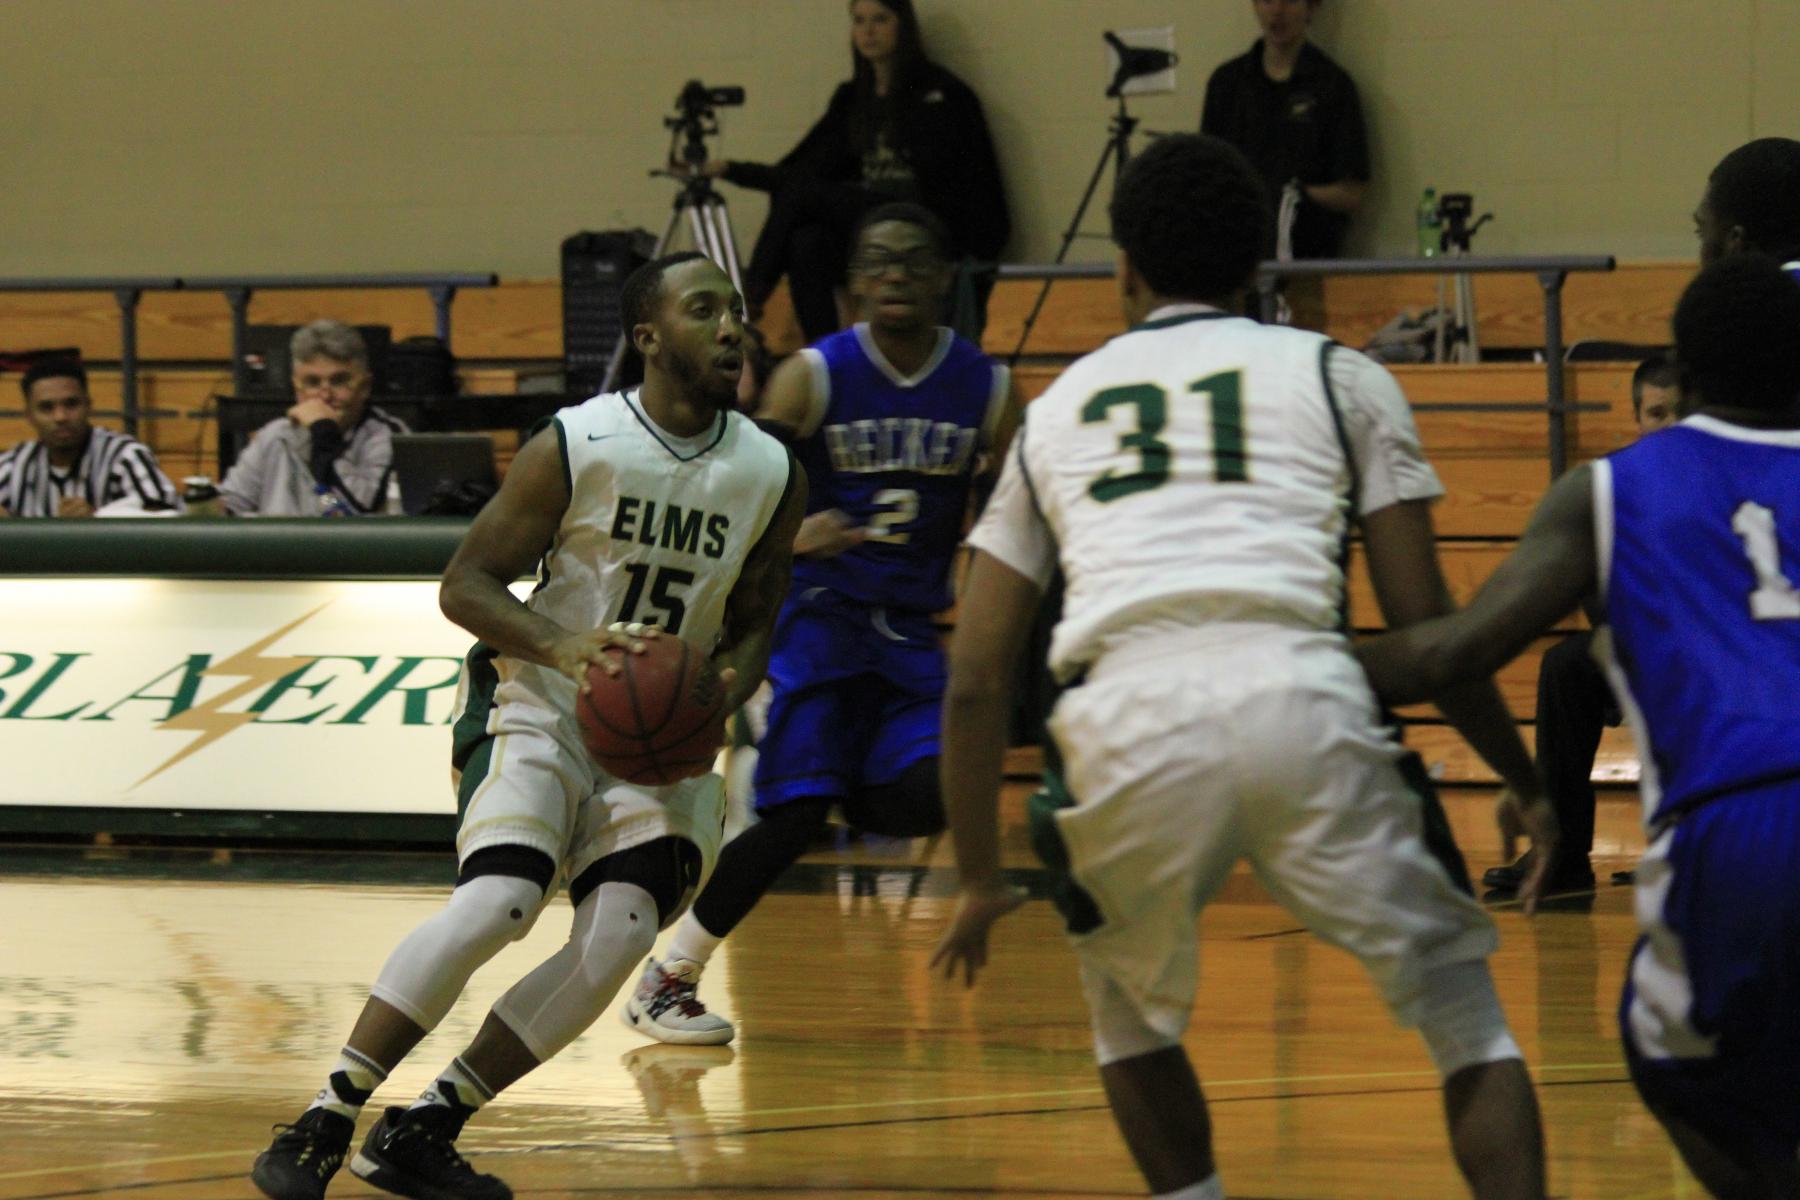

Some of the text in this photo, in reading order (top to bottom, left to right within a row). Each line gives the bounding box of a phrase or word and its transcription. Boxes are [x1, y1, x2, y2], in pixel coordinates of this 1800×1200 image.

[1080, 369, 1250, 503] 31
[610, 496, 730, 559] ELMS
[868, 488, 919, 543] 2
[1732, 501, 1800, 619] 1
[616, 563, 695, 635] 15
[0, 652, 464, 725] LAZER
